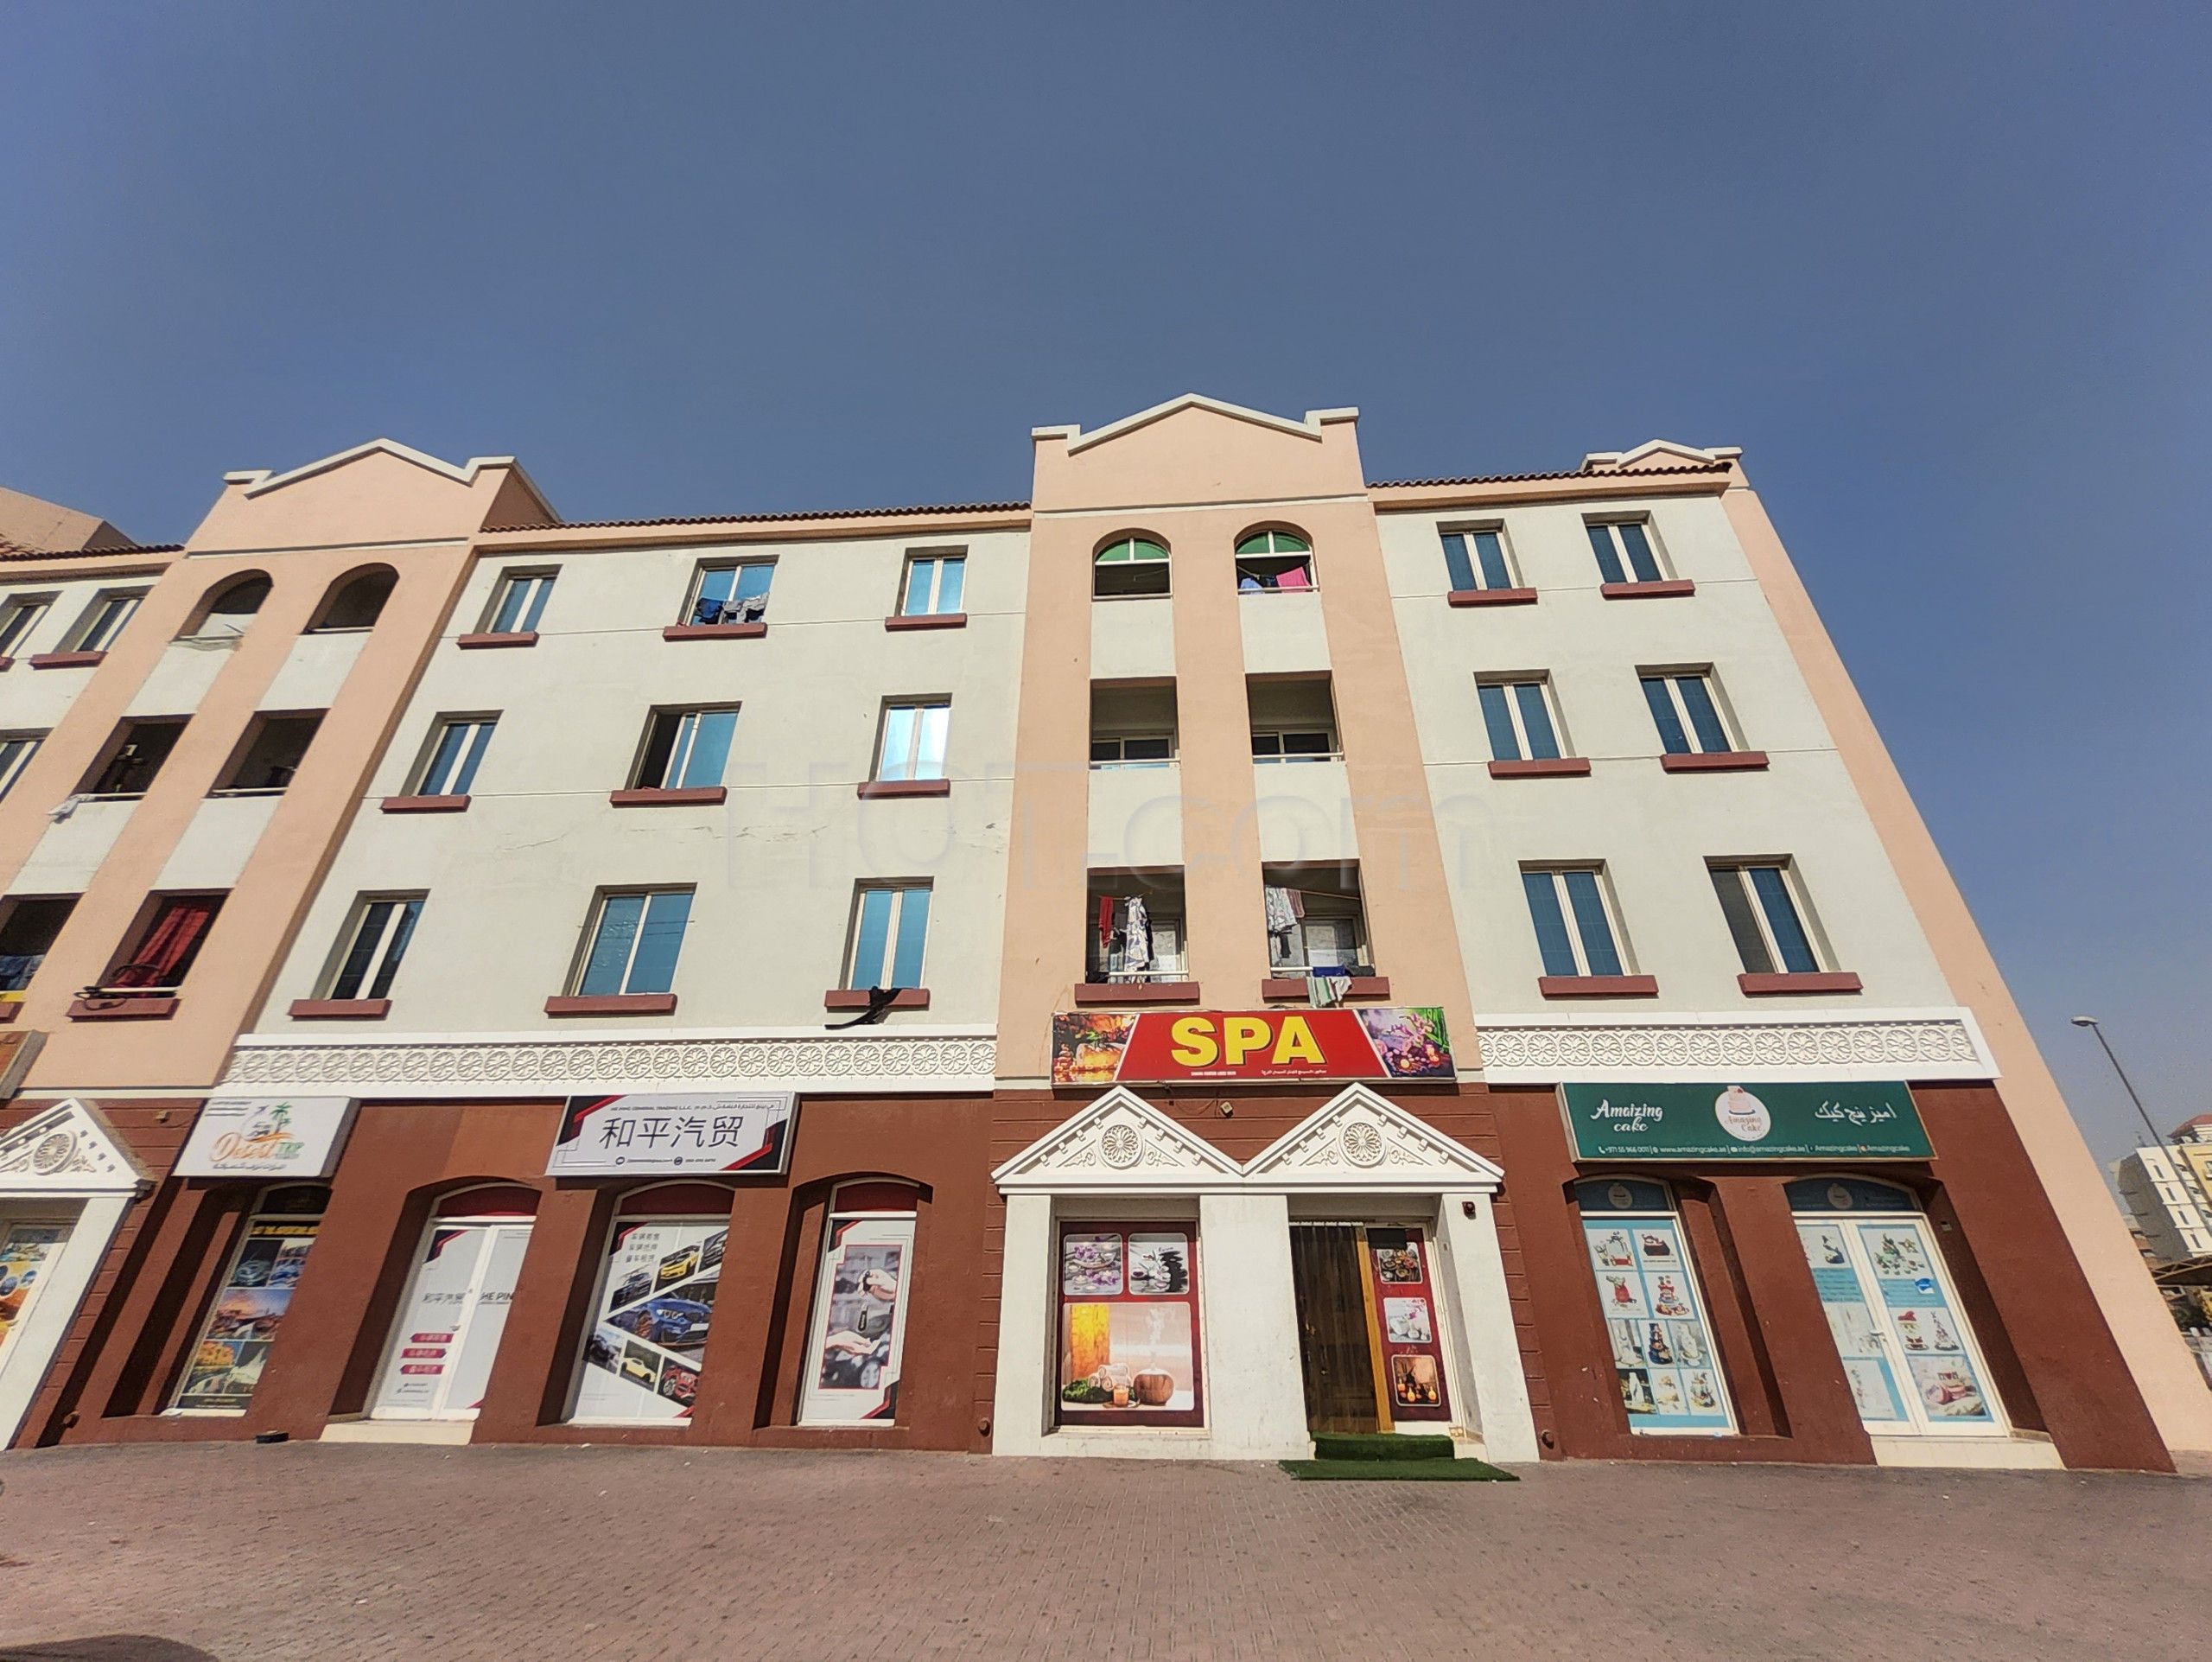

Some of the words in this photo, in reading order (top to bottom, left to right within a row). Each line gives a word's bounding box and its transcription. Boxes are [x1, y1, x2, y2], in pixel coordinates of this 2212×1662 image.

[1171, 1016, 1327, 1068] SPA
[1590, 1098, 1663, 1122] Amaizing
[1613, 1116, 1649, 1132] cake
[599, 1115, 744, 1149] 和平汽贸
